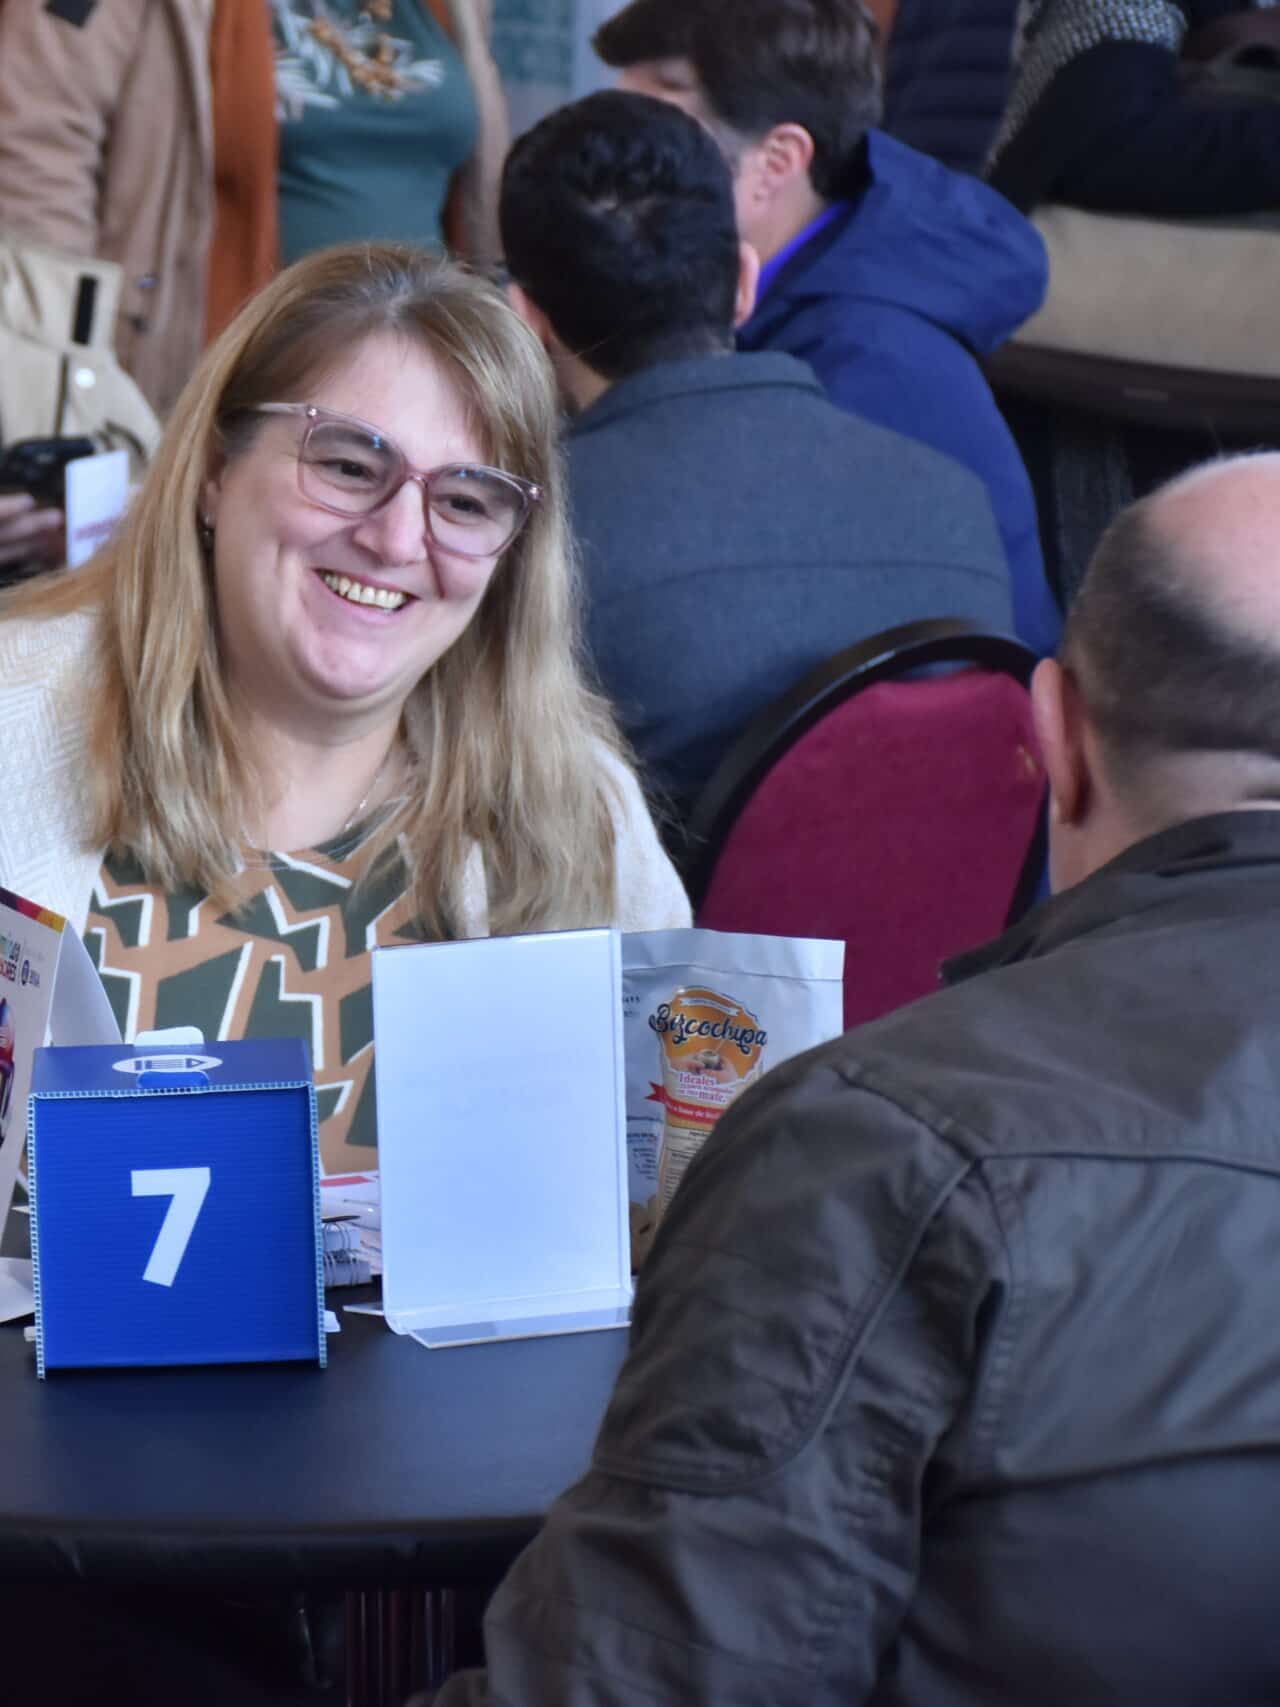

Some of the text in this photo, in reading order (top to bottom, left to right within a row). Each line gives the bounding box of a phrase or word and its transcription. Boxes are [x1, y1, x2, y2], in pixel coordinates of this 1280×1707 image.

[648, 1003, 767, 1055] Bizcochipa
[679, 1072, 715, 1087] Ideales
[131, 1166, 211, 1288] 7
